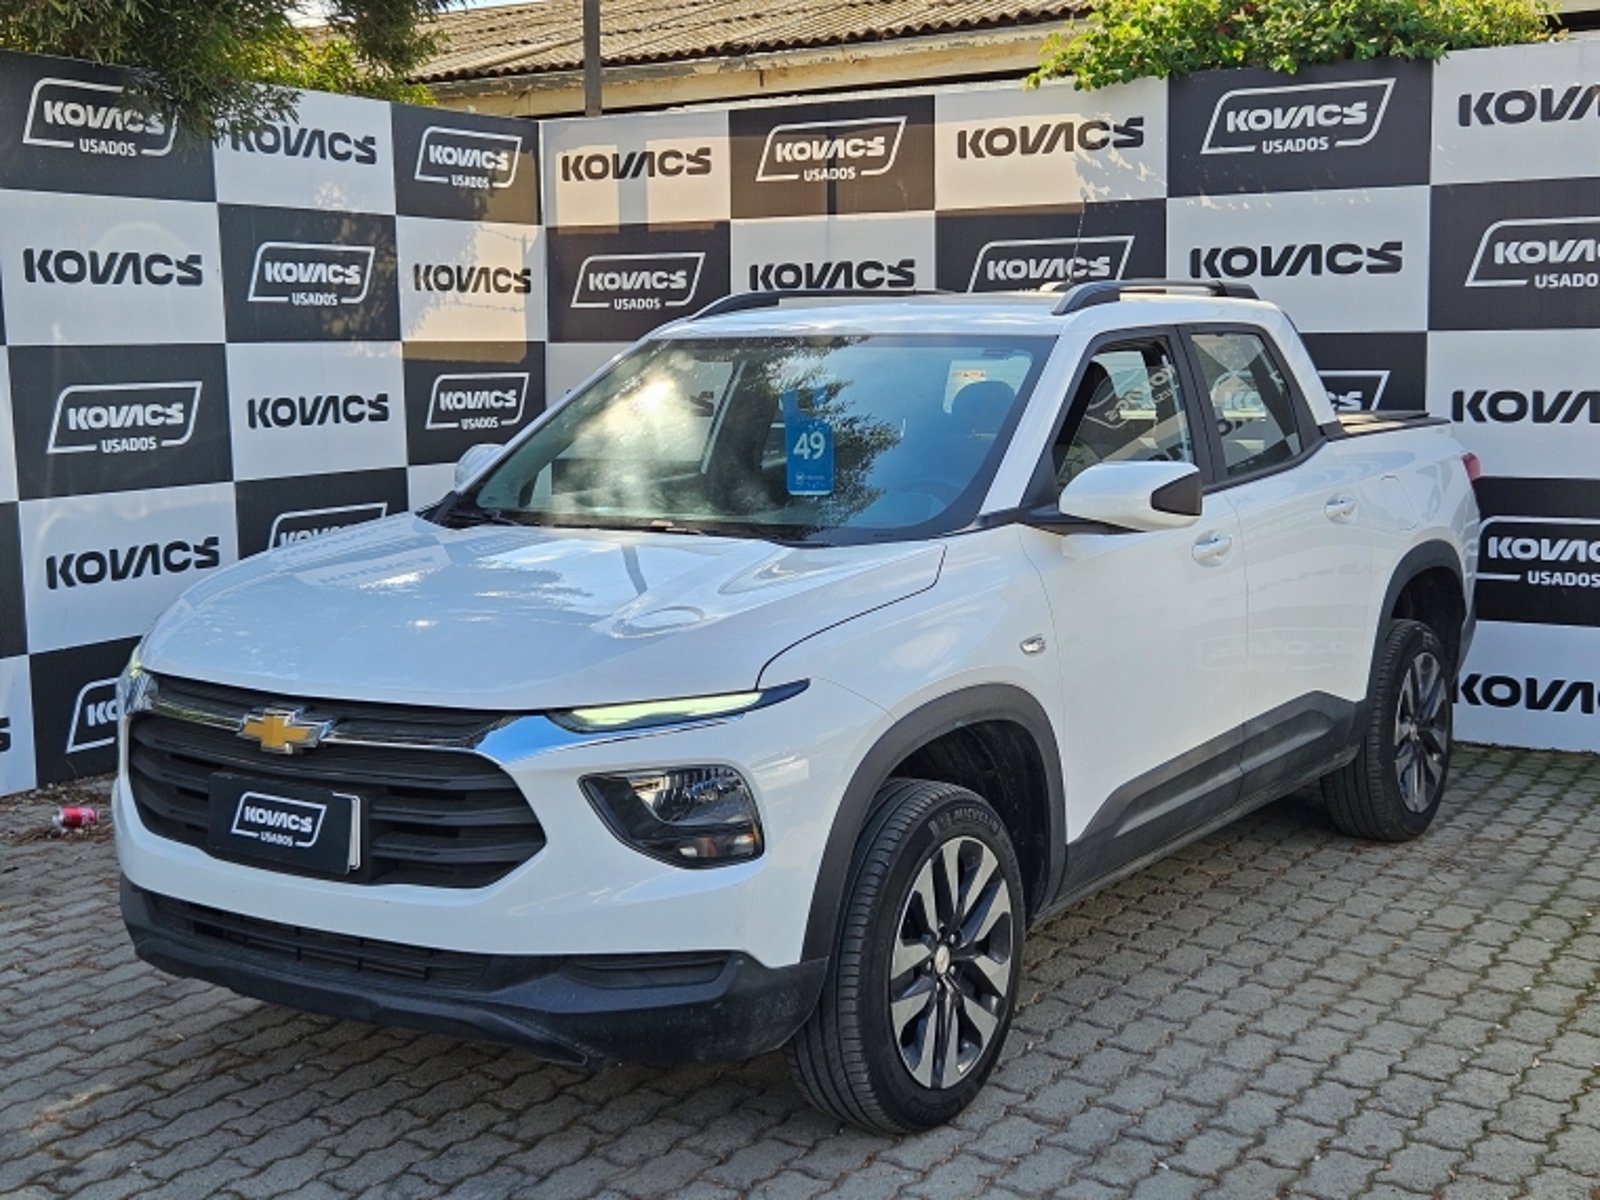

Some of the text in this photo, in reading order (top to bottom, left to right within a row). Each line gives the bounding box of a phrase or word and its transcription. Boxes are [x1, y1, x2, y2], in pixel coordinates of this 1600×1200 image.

[43, 100, 165, 134] KOVACS
[1226, 101, 1368, 132] KOVACS
[1458, 84, 1600, 127] KOVA
[79, 138, 137, 157] USADOS
[775, 136, 885, 163] KOVACS
[957, 116, 1144, 159] KOVACS
[1262, 137, 1329, 154] USADOS
[429, 144, 509, 171] KOVACS
[562, 147, 712, 181] KOVACS
[451, 174, 489, 189] USADOS
[803, 166, 856, 181] USADOS
[1190, 241, 1403, 278] KOVACS
[1494, 239, 1600, 264] KOVA
[23, 248, 203, 286] KOVACS
[264, 261, 361, 285] KOVACS
[412, 264, 532, 294] KOVACS
[749, 258, 916, 291] KOVACS
[987, 256, 1110, 280] KOVACS
[1534, 273, 1599, 288] USADO
[588, 271, 687, 291] KOVACS
[291, 292, 338, 306] USADOS
[613, 298, 661, 310] USADOS
[248, 393, 389, 429] KOVACS
[440, 390, 517, 410] KOVACS
[1452, 390, 1600, 423] KOVA
[68, 402, 184, 431] KOVACS
[460, 416, 498, 429] USADOS
[102, 436, 157, 453] USADOS
[793, 431, 826, 459] 49
[46, 536, 219, 590] KOVACS
[1527, 570, 1600, 588] USADOS
[1453, 673, 1600, 714] KOVA
[244, 806, 313, 833] KOVACS
[260, 831, 293, 847] USADOS
